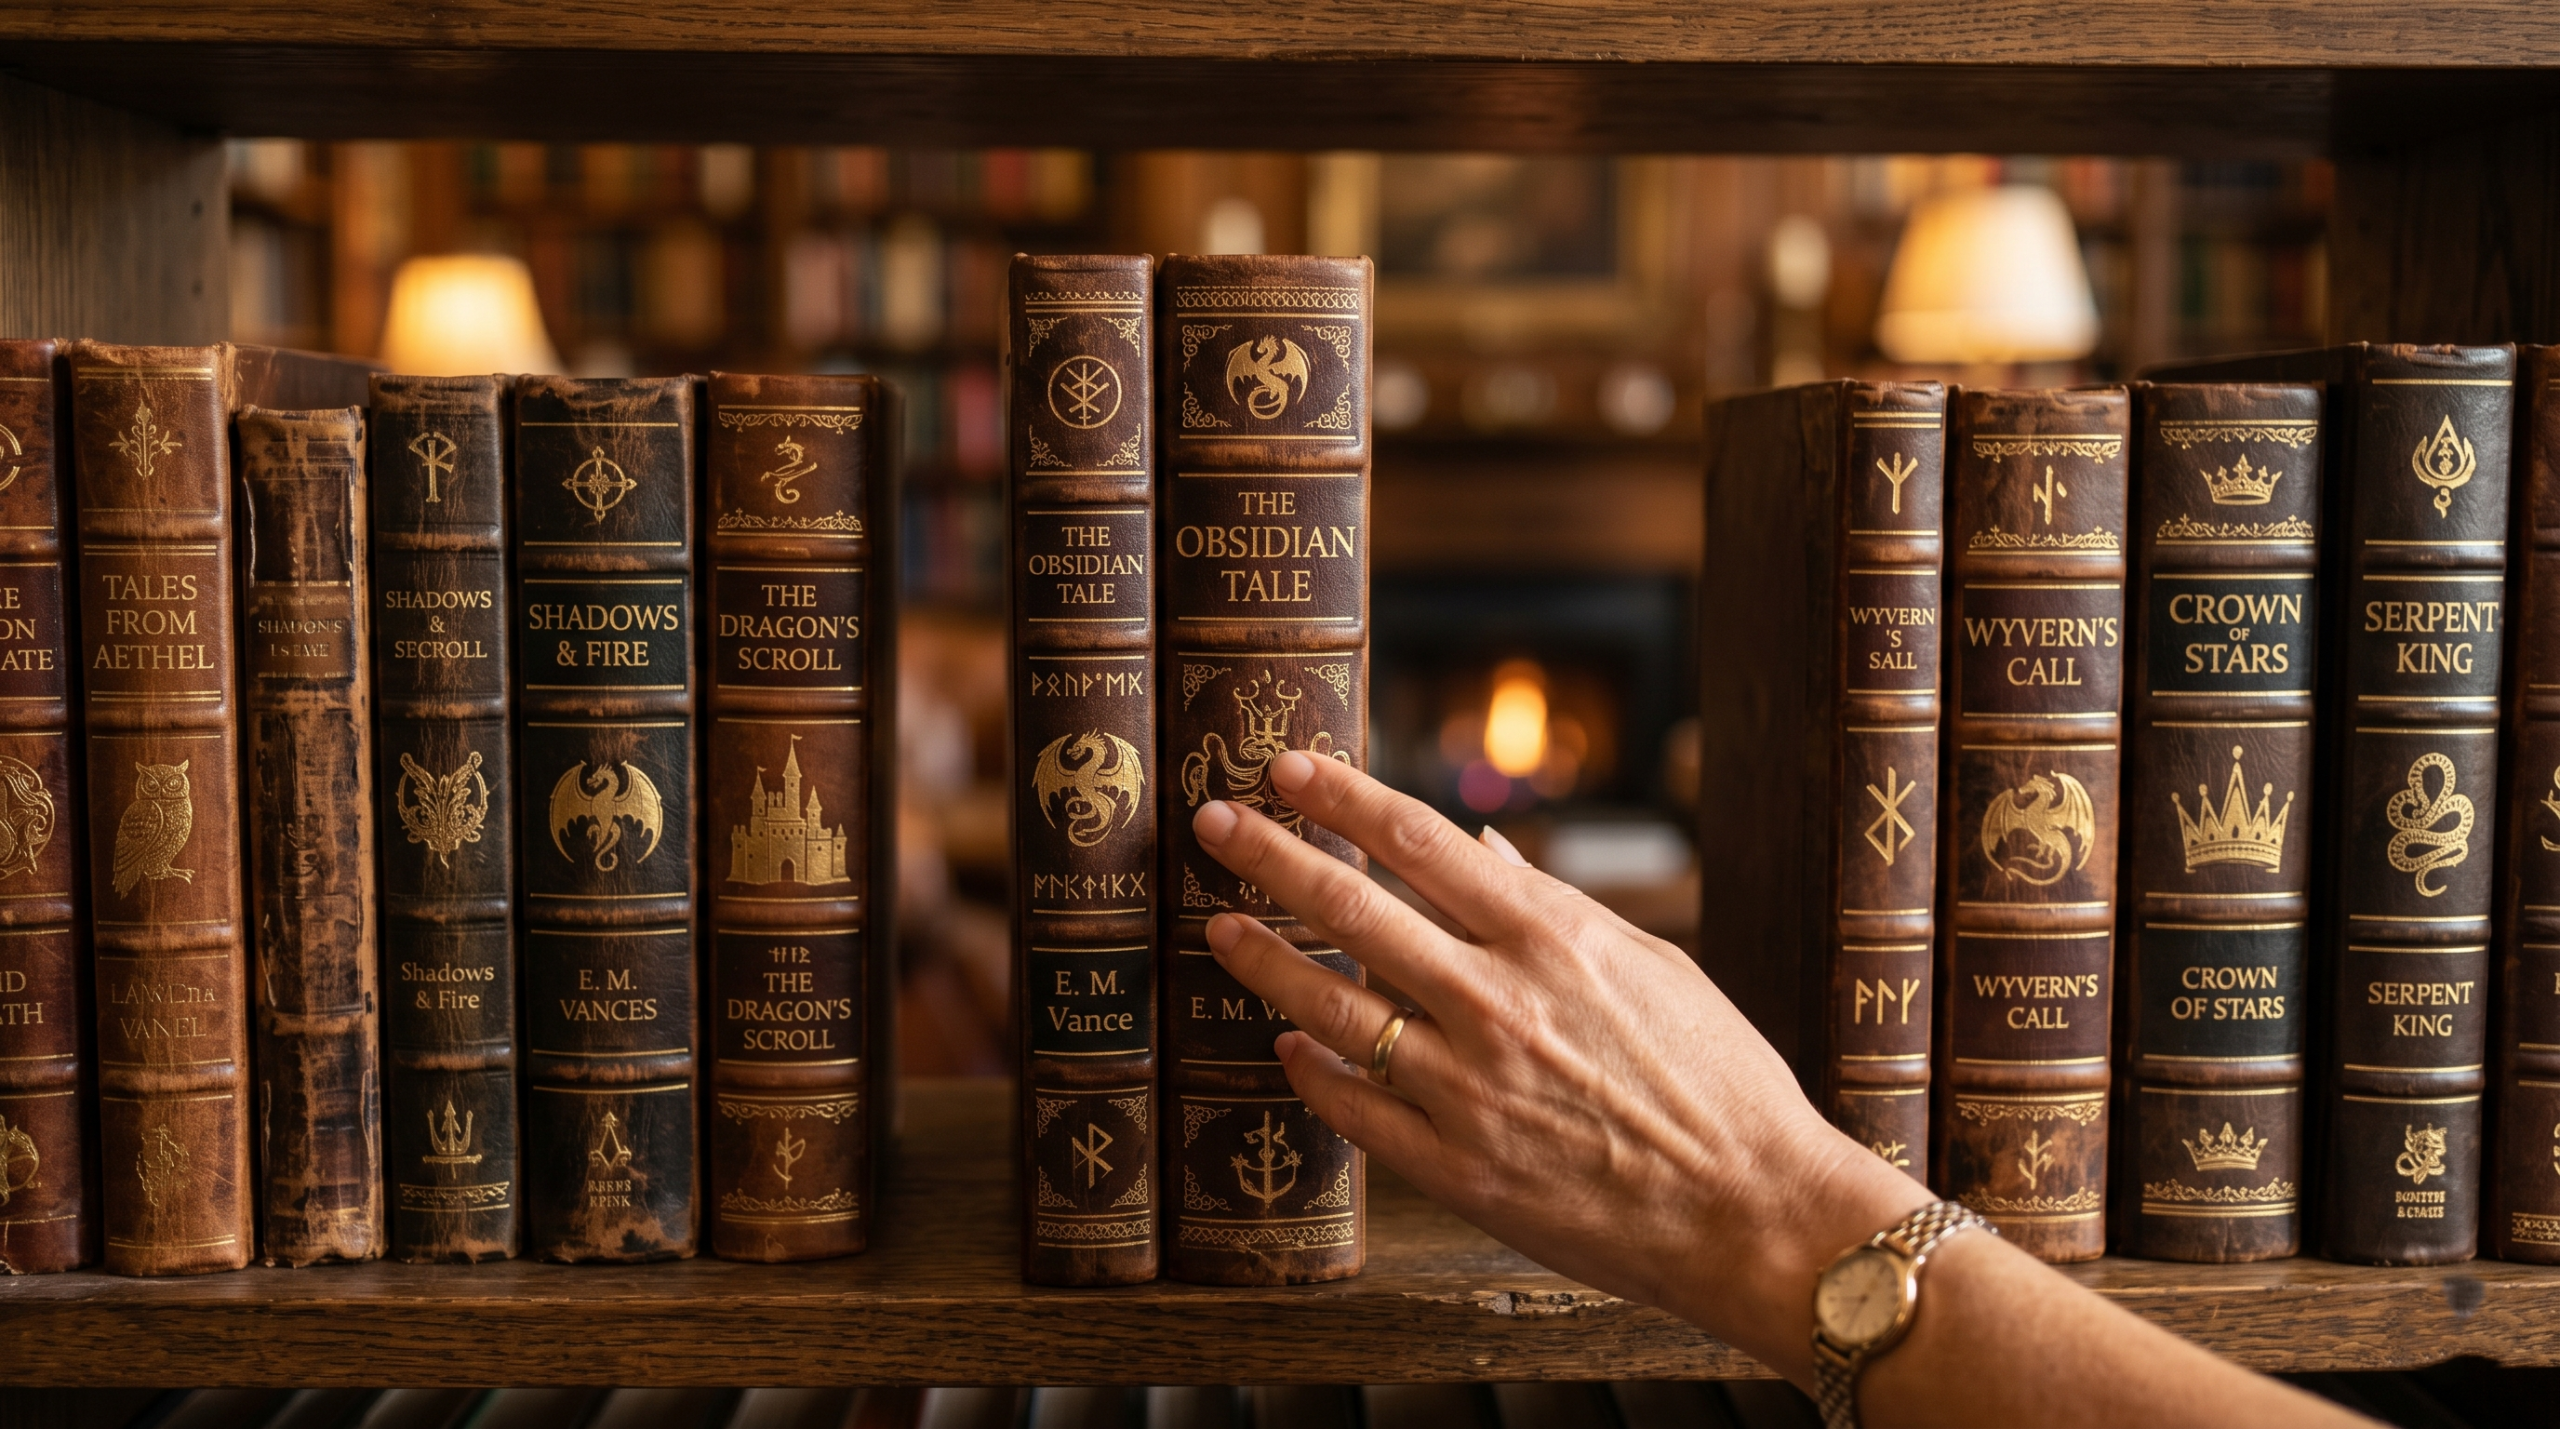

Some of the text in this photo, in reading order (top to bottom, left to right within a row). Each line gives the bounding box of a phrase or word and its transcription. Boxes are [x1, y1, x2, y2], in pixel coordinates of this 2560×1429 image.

[1238, 491, 1296, 516] THE
[1061, 526, 1111, 547] THE
[1175, 525, 1356, 559] OBSIDIAN
[1028, 554, 1144, 576] OBSIDIAN
[102, 575, 199, 601] TALES
[761, 585, 818, 608] THE
[1056, 583, 1116, 604] TALE
[1220, 569, 1313, 602] TALE
[385, 590, 493, 610] SHADOWS
[2168, 593, 2303, 625] CROWN
[105, 609, 198, 635] FROM
[429, 615, 446, 634] &
[528, 604, 680, 631] SHADOWS
[719, 613, 861, 641] DRAGON'S
[1849, 607, 1936, 626] WYVERN
[2364, 601, 2499, 633] SERPENT
[1885, 629, 1903, 649] 'S
[1964, 616, 2120, 649] WYVERN'S
[2229, 626, 2251, 642] OF
[92, 644, 215, 670] AETHEL
[394, 640, 488, 660] SECROLL
[556, 641, 651, 667] & FIRE
[737, 646, 843, 672] SCROLL
[1868, 652, 1918, 671] SALL
[2184, 642, 2290, 675] STARS
[2395, 642, 2474, 675] KING
[2006, 657, 2082, 687] CALL
[401, 961, 495, 982] Shadows
[578, 969, 638, 991] E. M.
[763, 972, 814, 993] THE
[1054, 970, 1126, 996] E. M.
[2181, 965, 2279, 990] CROWN
[1972, 974, 2099, 999] WYVERN'S
[2367, 980, 2475, 1006] SERPENT
[415, 989, 481, 1010] & Fire
[559, 999, 658, 1022] VANCES
[727, 998, 852, 1022] DRAGON'S
[1190, 996, 1213, 1020] E.
[1221, 998, 1253, 1021] M.
[2170, 996, 2286, 1021] OF STARS
[0, 1002, 44, 1025] TH
[1047, 1006, 1134, 1033] Vance
[2006, 1006, 2070, 1030] CALL
[2392, 1013, 2454, 1037] KING
[743, 1028, 836, 1052] SCROLL
